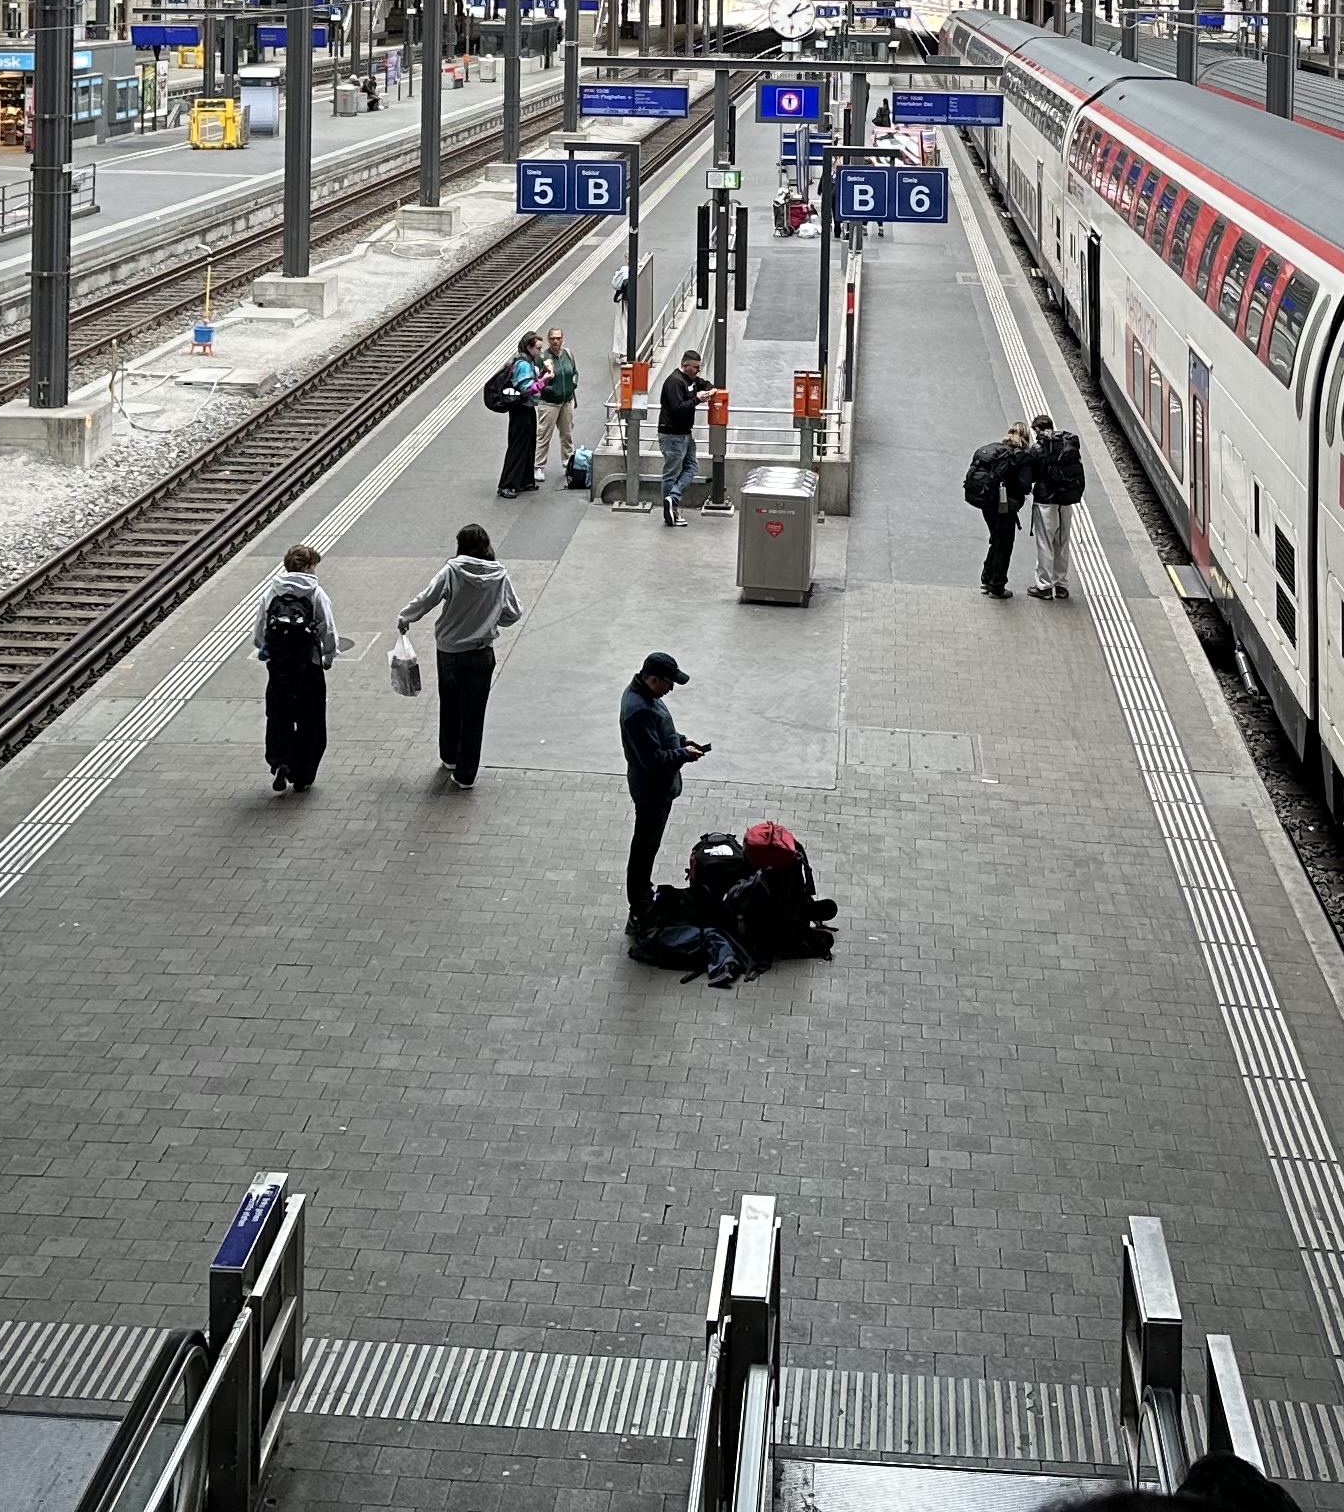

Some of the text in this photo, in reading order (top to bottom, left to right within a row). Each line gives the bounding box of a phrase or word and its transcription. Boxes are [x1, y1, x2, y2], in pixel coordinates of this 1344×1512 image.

[533, 177, 554, 205] 5
[587, 178, 610, 205] B
[853, 184, 875, 211] B
[909, 185, 931, 213] 6
